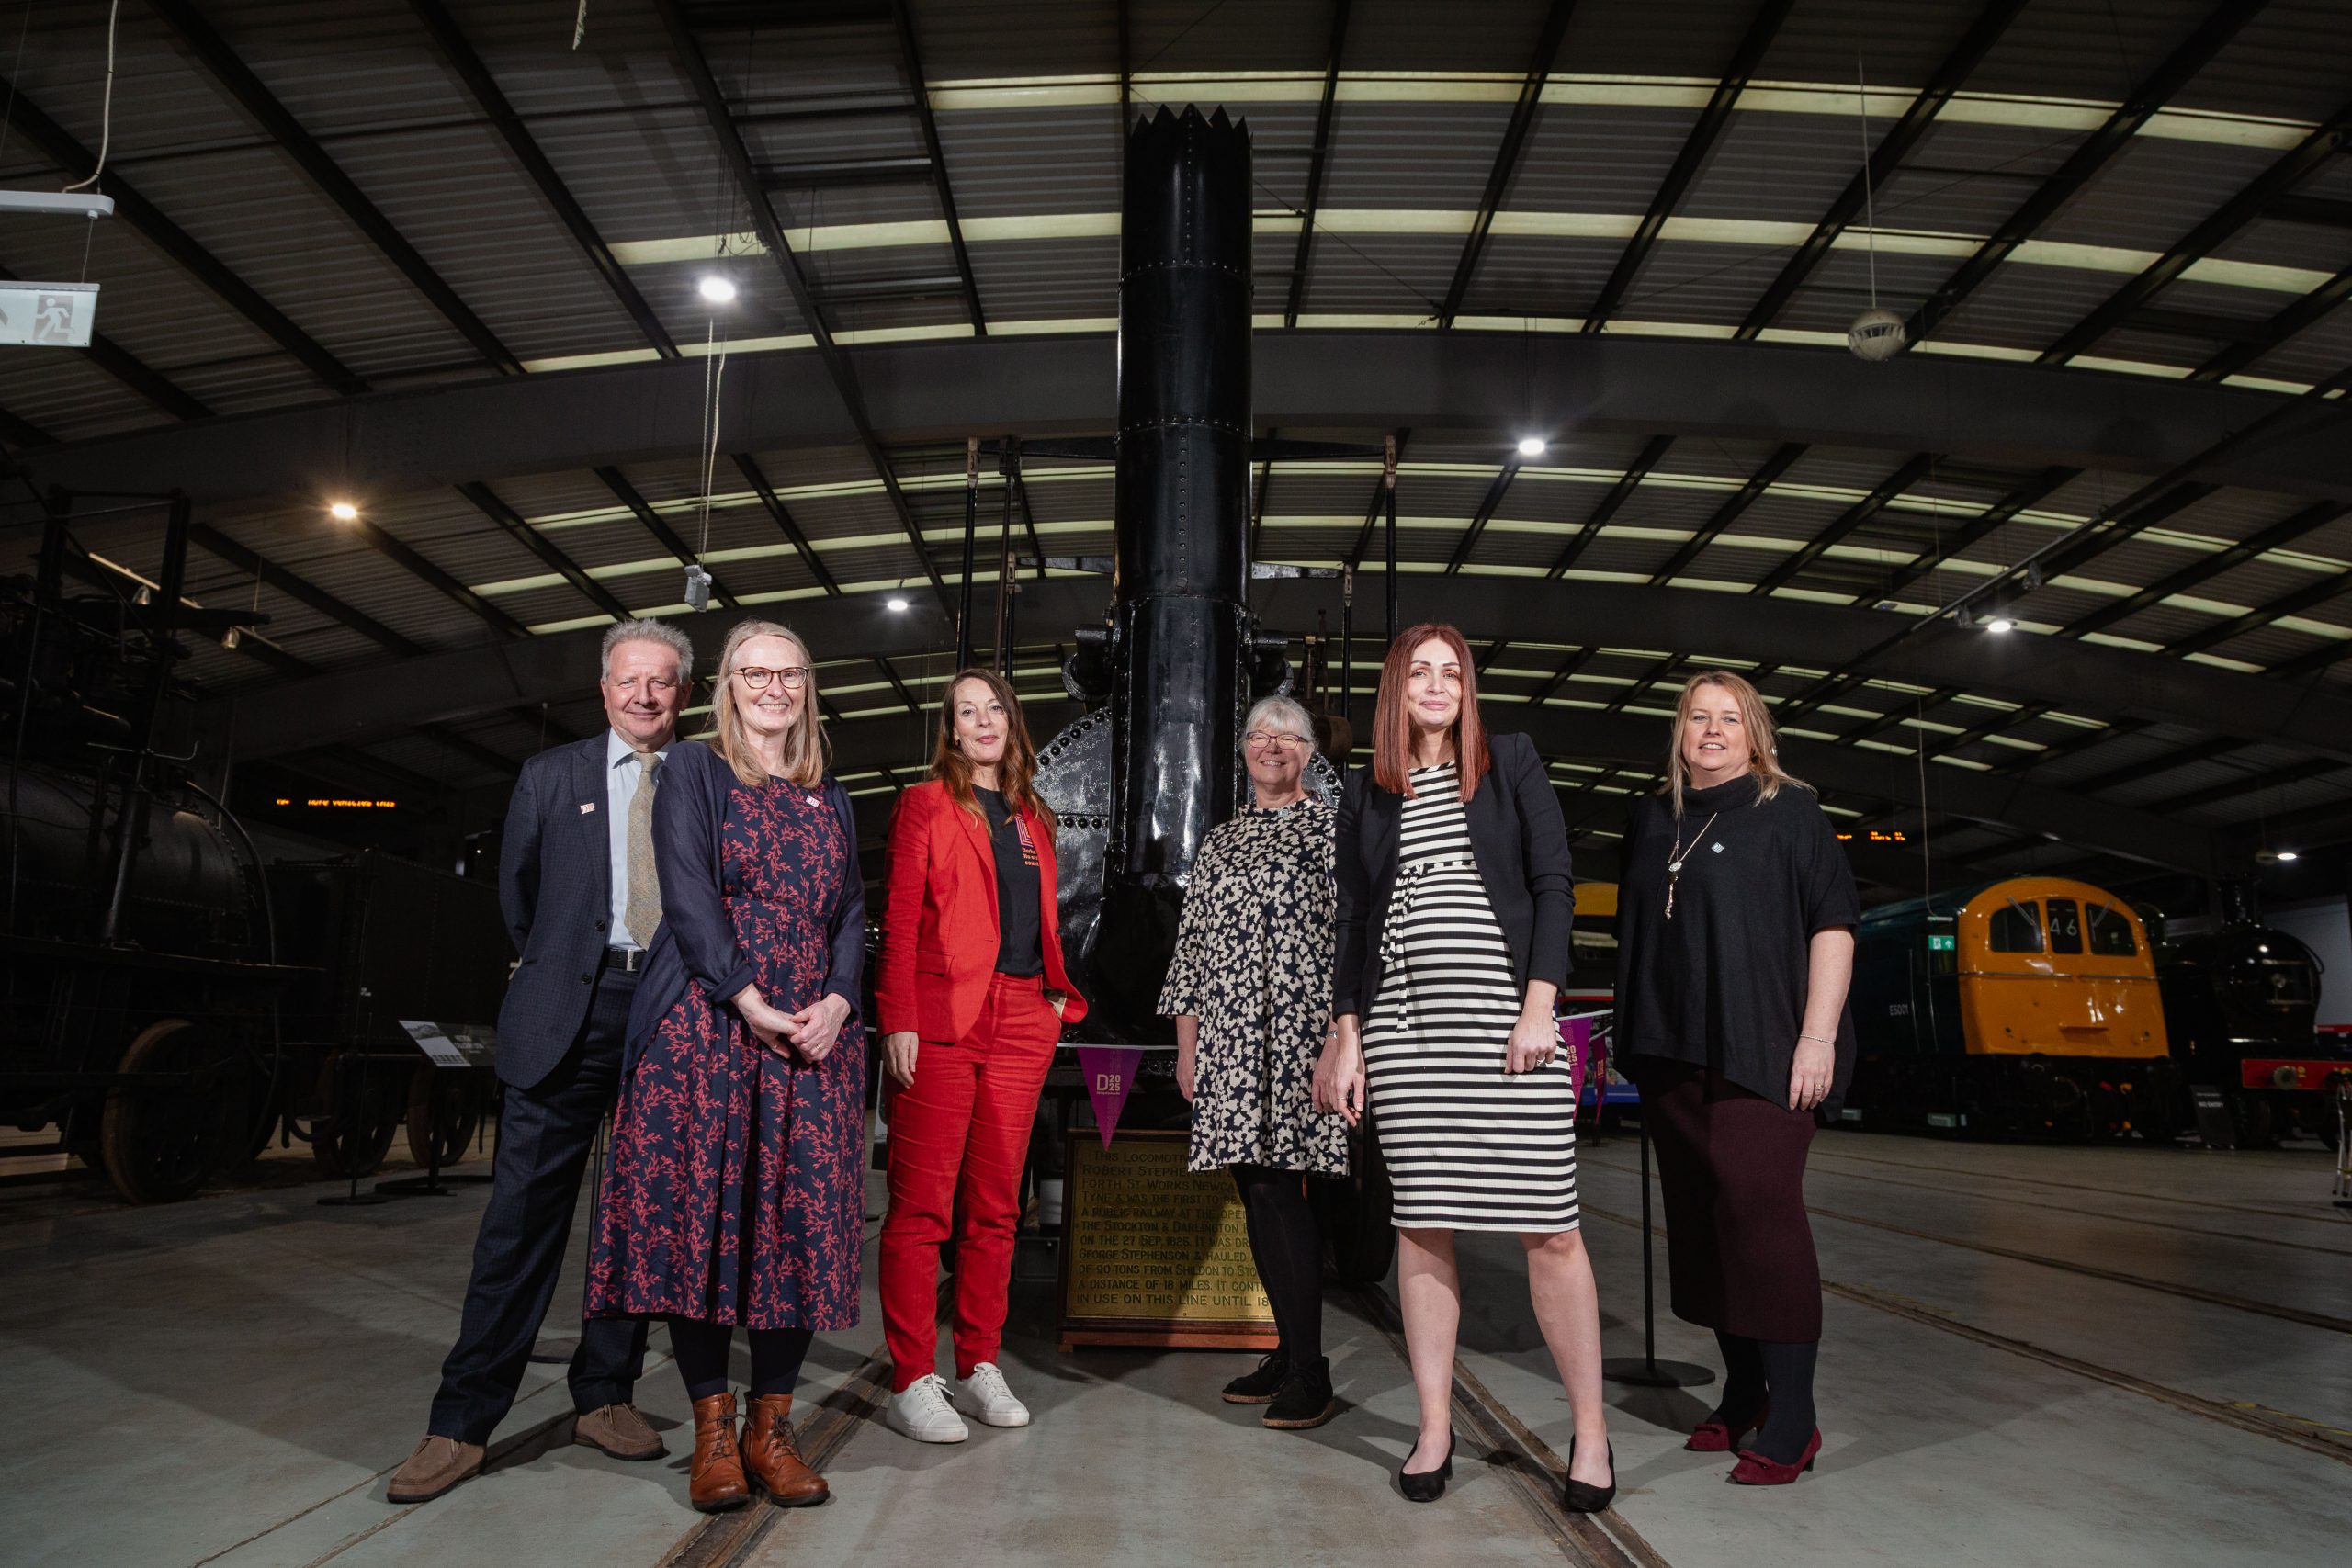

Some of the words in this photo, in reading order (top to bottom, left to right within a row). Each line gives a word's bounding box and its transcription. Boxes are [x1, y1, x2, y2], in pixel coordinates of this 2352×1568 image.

[1094, 1150, 1119, 1162] THIS
[1082, 1164, 1134, 1177] ROBERT
[1082, 1178, 1122, 1190] FORTH
[1081, 1190, 1111, 1202] TYNE
[1115, 1193, 1124, 1203] &
[1126, 1192, 1148, 1204] WAS
[1152, 1194, 1170, 1204] THE
[1173, 1194, 1201, 1205] FIRST
[1204, 1194, 1220, 1205] TO
[1224, 1195, 1237, 1206] BE
[1081, 1207, 1089, 1217] A
[1092, 1206, 1130, 1218] PUBLIC
[1133, 1207, 1176, 1219] RAILWAY
[1180, 1209, 1192, 1219] AT
[1195, 1209, 1216, 1220] THE
[1081, 1220, 1102, 1232] THE
[1104, 1219, 1159, 1232] STOCKTON
[1161, 1221, 1170, 1234] &
[1172, 1221, 1238, 1234] DARLINGTON
[1080, 1235, 1094, 1246] ON
[1099, 1235, 1119, 1246] THE
[1123, 1235, 1136, 1247] 27
[1195, 1234, 1205, 1247] IT
[1209, 1236, 1232, 1247] WAS
[1079, 1247, 1119, 1260] GEORGE
[1121, 1247, 1190, 1261] STEPHENSON
[1193, 1250, 1204, 1261] &
[1206, 1251, 1248, 1262] HAULED
[1079, 1264, 1093, 1275] OF
[1096, 1263, 1111, 1275] 90
[1114, 1264, 1140, 1275] TONS
[1144, 1264, 1173, 1276] FROM
[1176, 1263, 1219, 1277] SHILDON
[1222, 1266, 1234, 1277] TO
[1078, 1279, 1087, 1289] A
[1090, 1279, 1140, 1290] DISTANCE
[1145, 1279, 1159, 1291] OF
[1164, 1280, 1175, 1291] 18
[1179, 1280, 1213, 1292] MILES.
[1216, 1278, 1227, 1292] IT
[1077, 1292, 1090, 1303] IN
[1093, 1292, 1119, 1304] USE
[1123, 1293, 1142, 1304] ON
[1146, 1293, 1174, 1304] THIS
[1178, 1294, 1208, 1305] LINE
[1213, 1295, 1252, 1307] UNTIL
